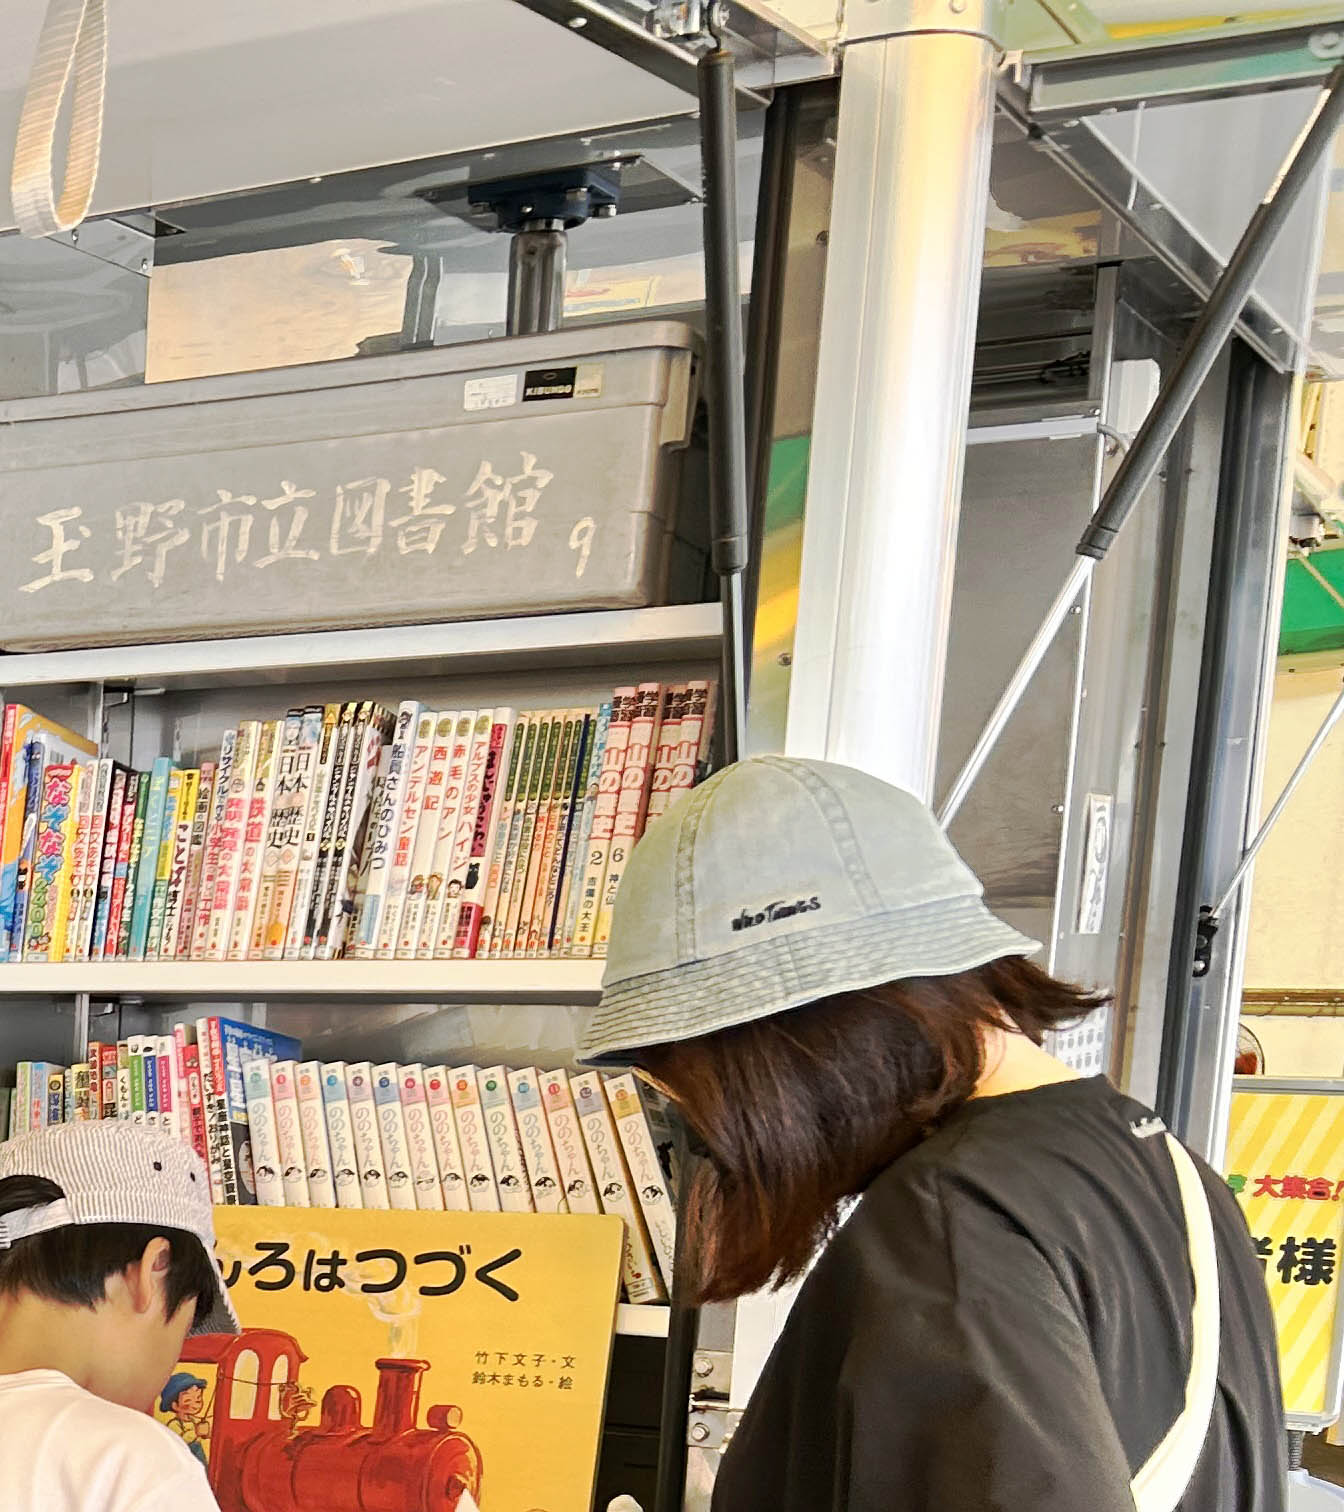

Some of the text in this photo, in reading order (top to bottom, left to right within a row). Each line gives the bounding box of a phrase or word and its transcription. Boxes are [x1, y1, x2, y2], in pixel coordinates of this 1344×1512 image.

[18, 450, 595, 594] 玉野市立図書館 9
[392, 745, 428, 868] アンデルセン童話
[423, 745, 448, 811] 西遊記
[438, 744, 467, 842] 赤毛のアン
[452, 741, 487, 871] アルプスの少女ハイジ
[590, 850, 603, 866] 2
[612, 847, 624, 864] 6
[251, 1101, 273, 1164] ののちゃん
[277, 1103, 299, 1165] ののちゃん
[301, 1104, 321, 1166] ののちゃん
[328, 1105, 350, 1167] ののちゃん
[355, 1106, 377, 1168] ののちゃん
[381, 1107, 404, 1170] ののちゃん
[407, 1107, 431, 1172] ののちゃん
[432, 1109, 457, 1172] ののちゃん
[460, 1109, 483, 1173] ののちゃん
[489, 1110, 515, 1175] ののちゃん
[522, 1111, 549, 1176] ののちゃん
[553, 1112, 581, 1177] ののちゃん
[586, 1116, 616, 1181] ののちゃん
[623, 1119, 654, 1183] ののちゃん
[471, 1372, 575, 1392] 鈴木まもる・絵
[475, 1351, 577, 1371] 竹下文子・文
